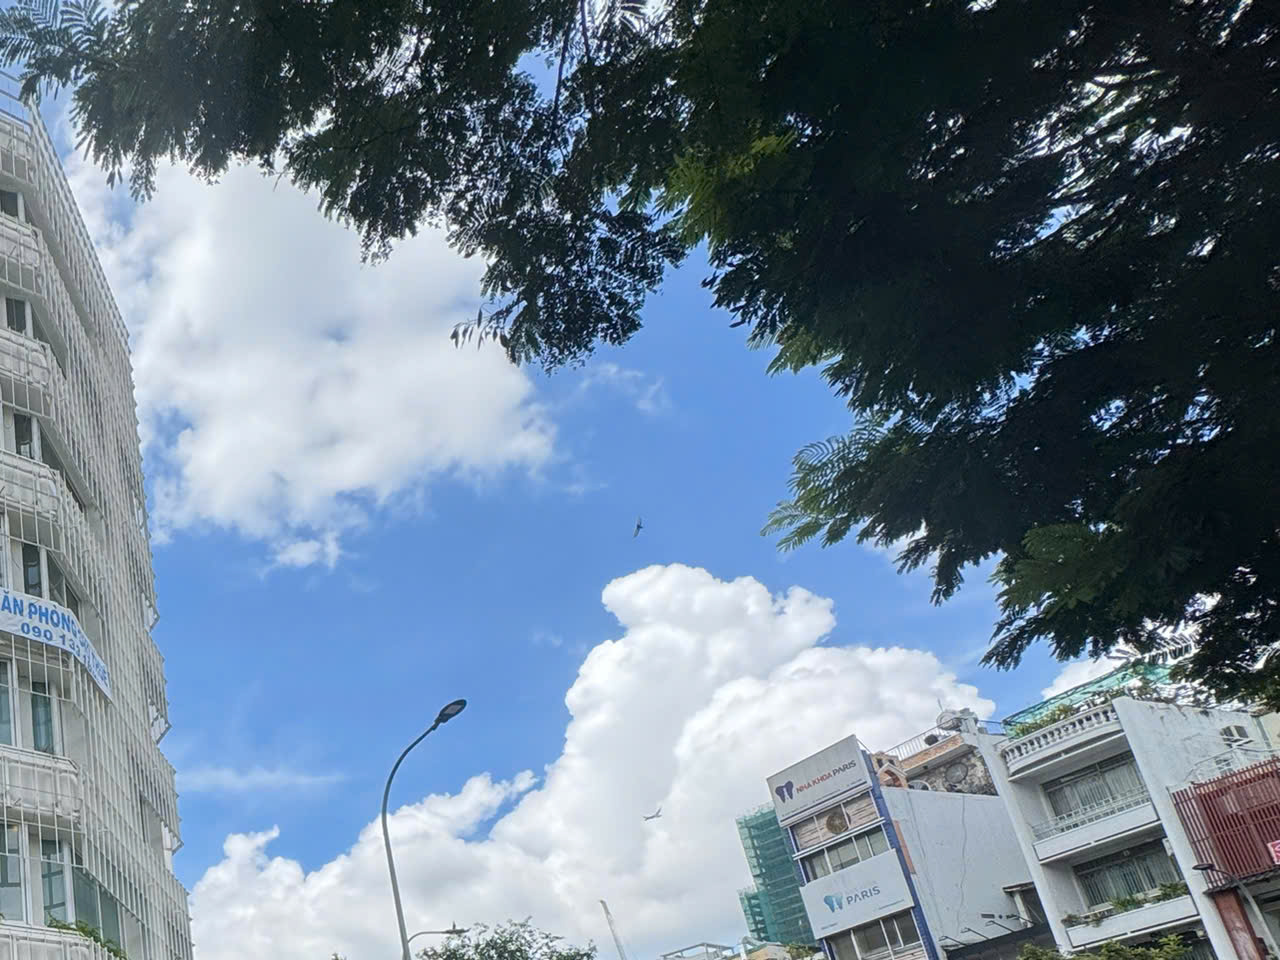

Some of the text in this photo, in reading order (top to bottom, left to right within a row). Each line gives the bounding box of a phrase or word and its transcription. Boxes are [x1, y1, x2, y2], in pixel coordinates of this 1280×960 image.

[21, 622, 53, 640] 090
[28, 604, 78, 638] PHÒNG
[796, 760, 857, 794] NHA KHOA PARIS
[846, 886, 880, 904] PARIS
